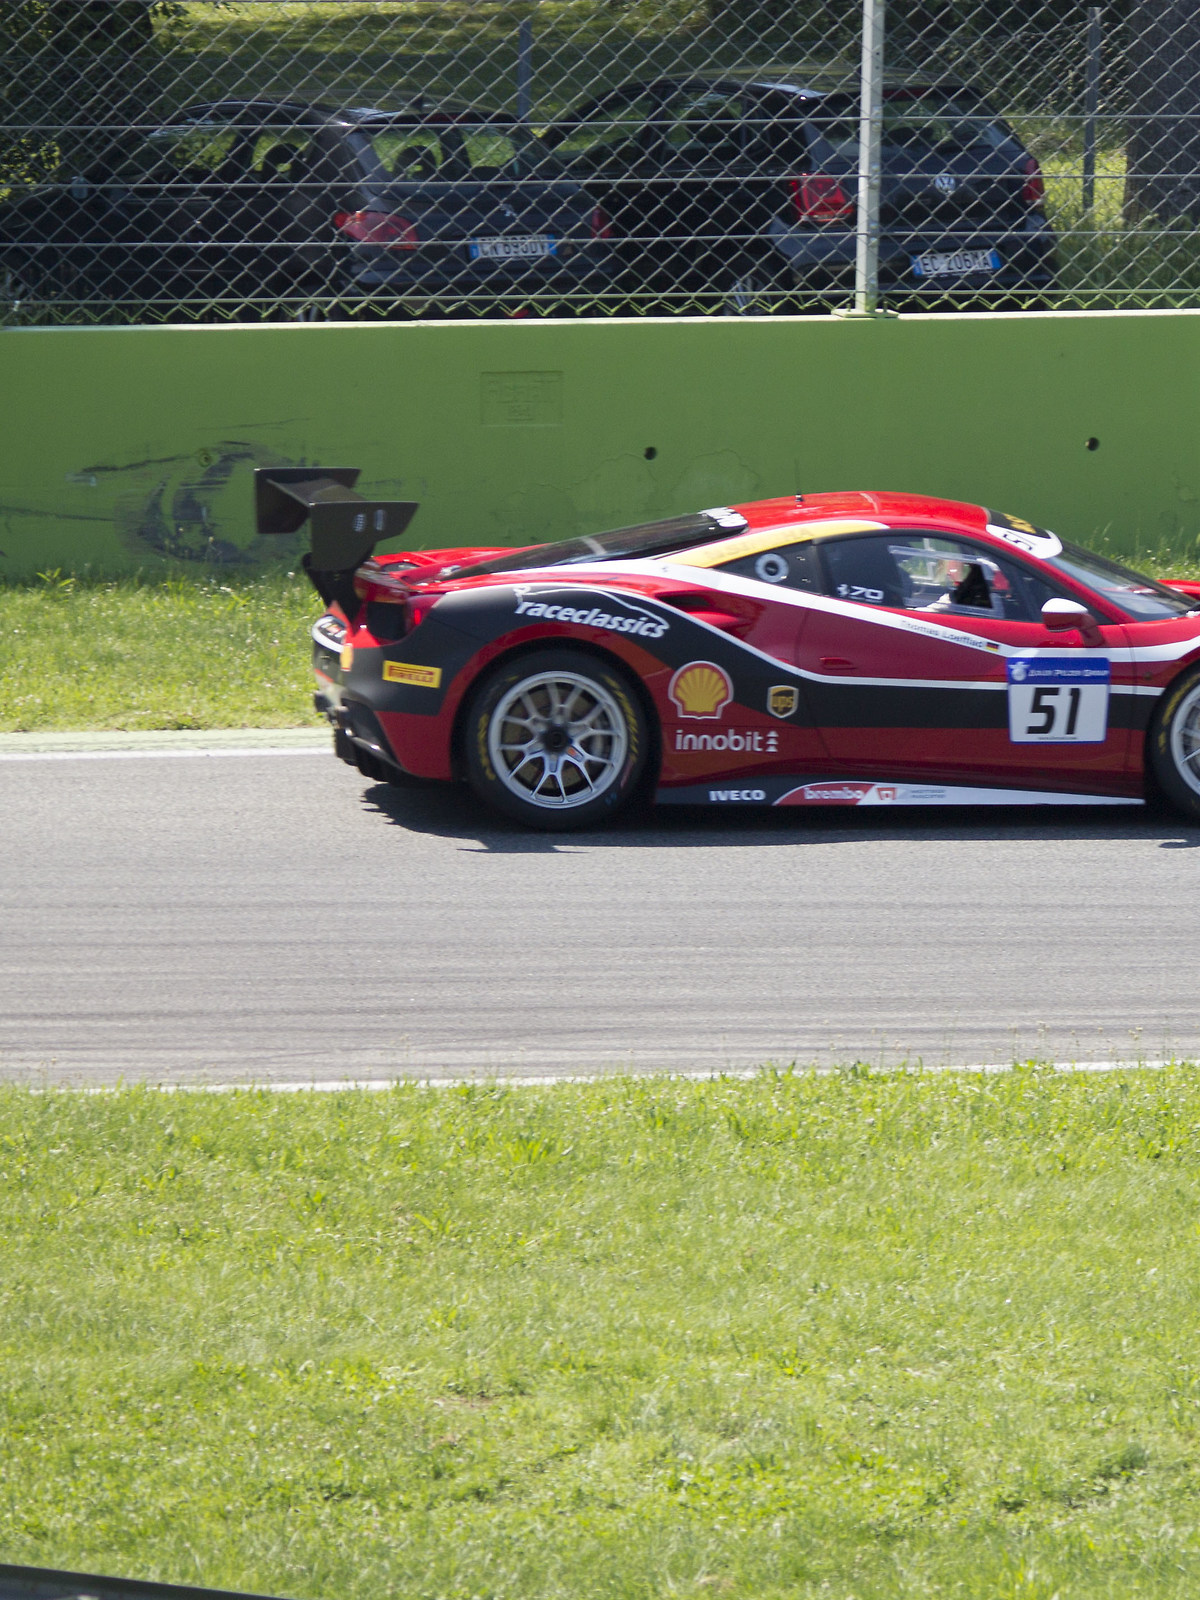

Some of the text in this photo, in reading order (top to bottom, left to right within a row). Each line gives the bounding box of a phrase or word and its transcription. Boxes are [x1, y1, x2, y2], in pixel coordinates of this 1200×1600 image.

[515, 601, 669, 638] raceclassics
[771, 695, 794, 712] ups
[1026, 687, 1082, 735] 51
[675, 729, 764, 752] innobit
[708, 789, 767, 801] IVECO
[803, 787, 864, 800] brembo
